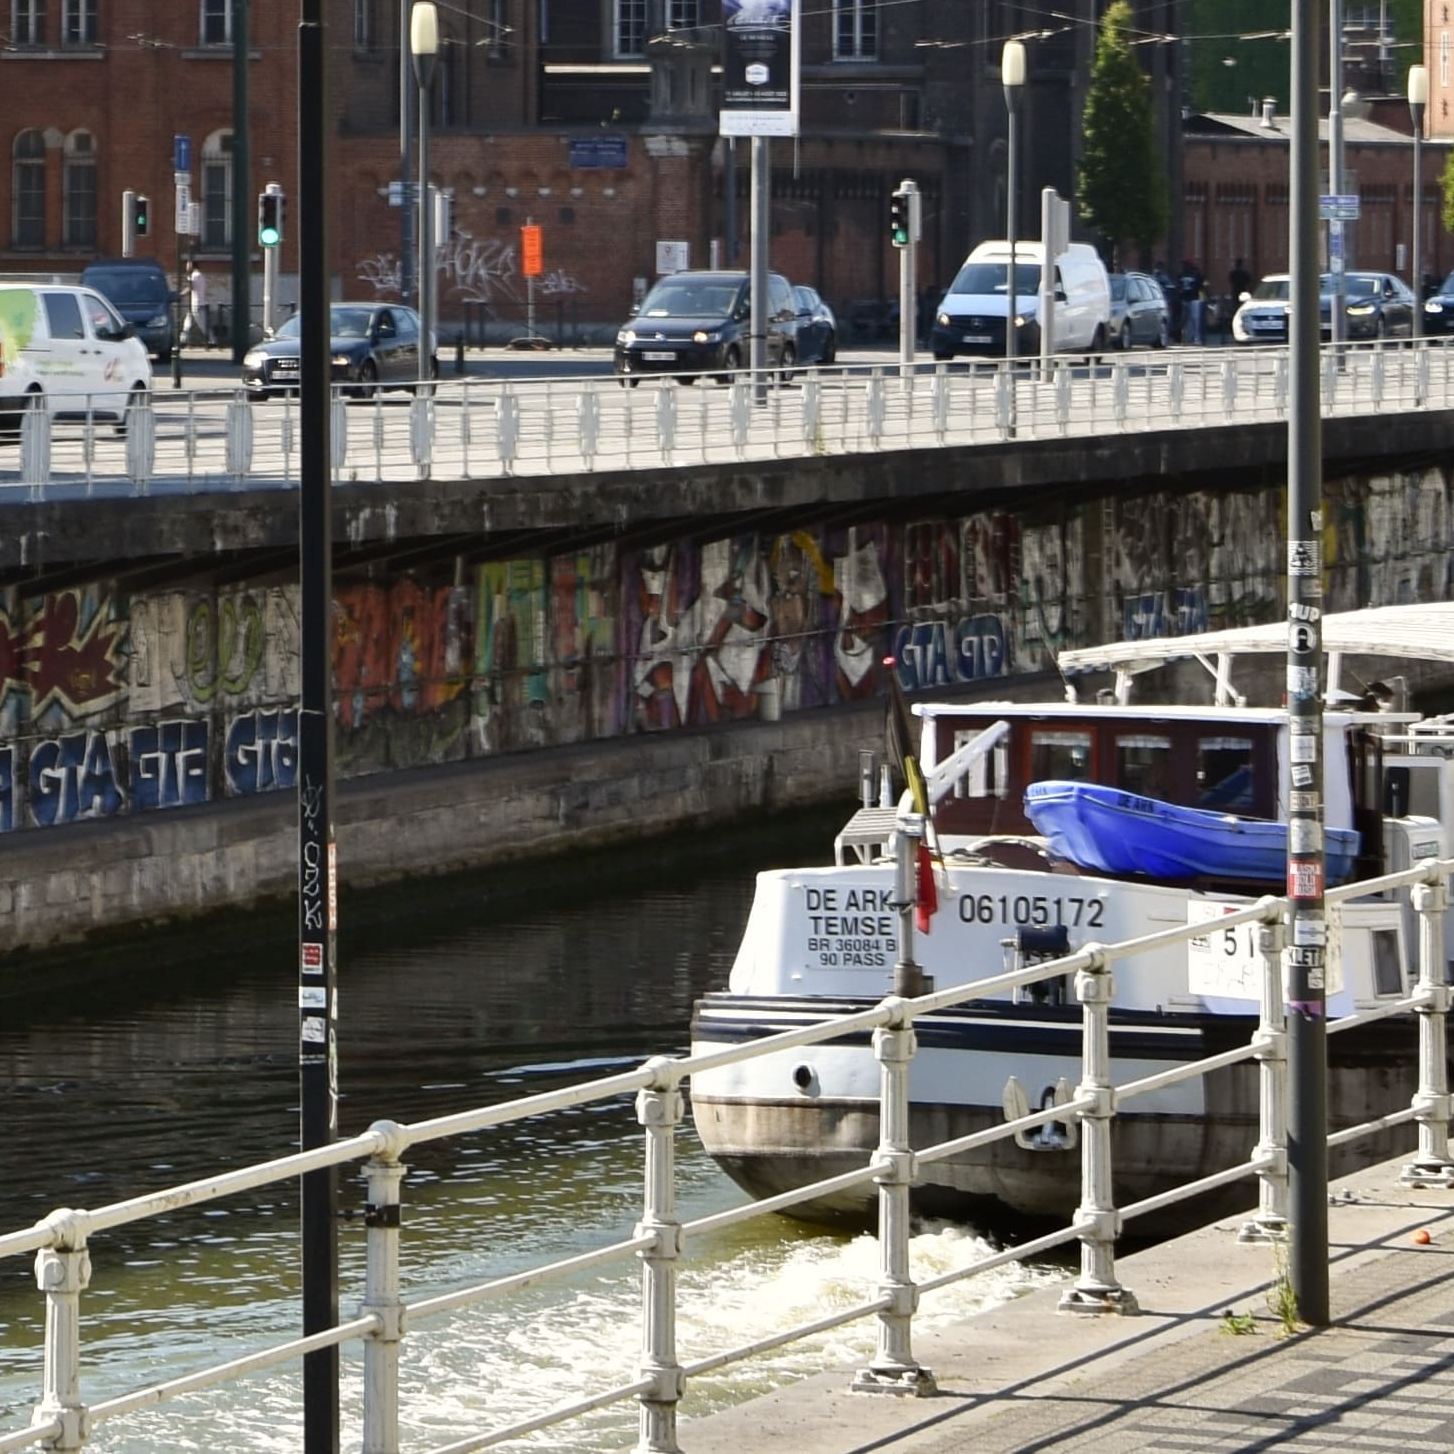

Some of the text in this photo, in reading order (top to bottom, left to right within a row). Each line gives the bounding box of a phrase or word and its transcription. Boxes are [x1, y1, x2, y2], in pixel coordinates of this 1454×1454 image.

[29, 728, 125, 827] GTA
[806, 889, 895, 912] DE ARK
[959, 894, 1104, 928] 06105172
[811, 916, 893, 936] TEMSE
[808, 939, 829, 952] BR
[835, 938, 880, 952] 36084
[820, 953, 886, 967] 90 PASS
